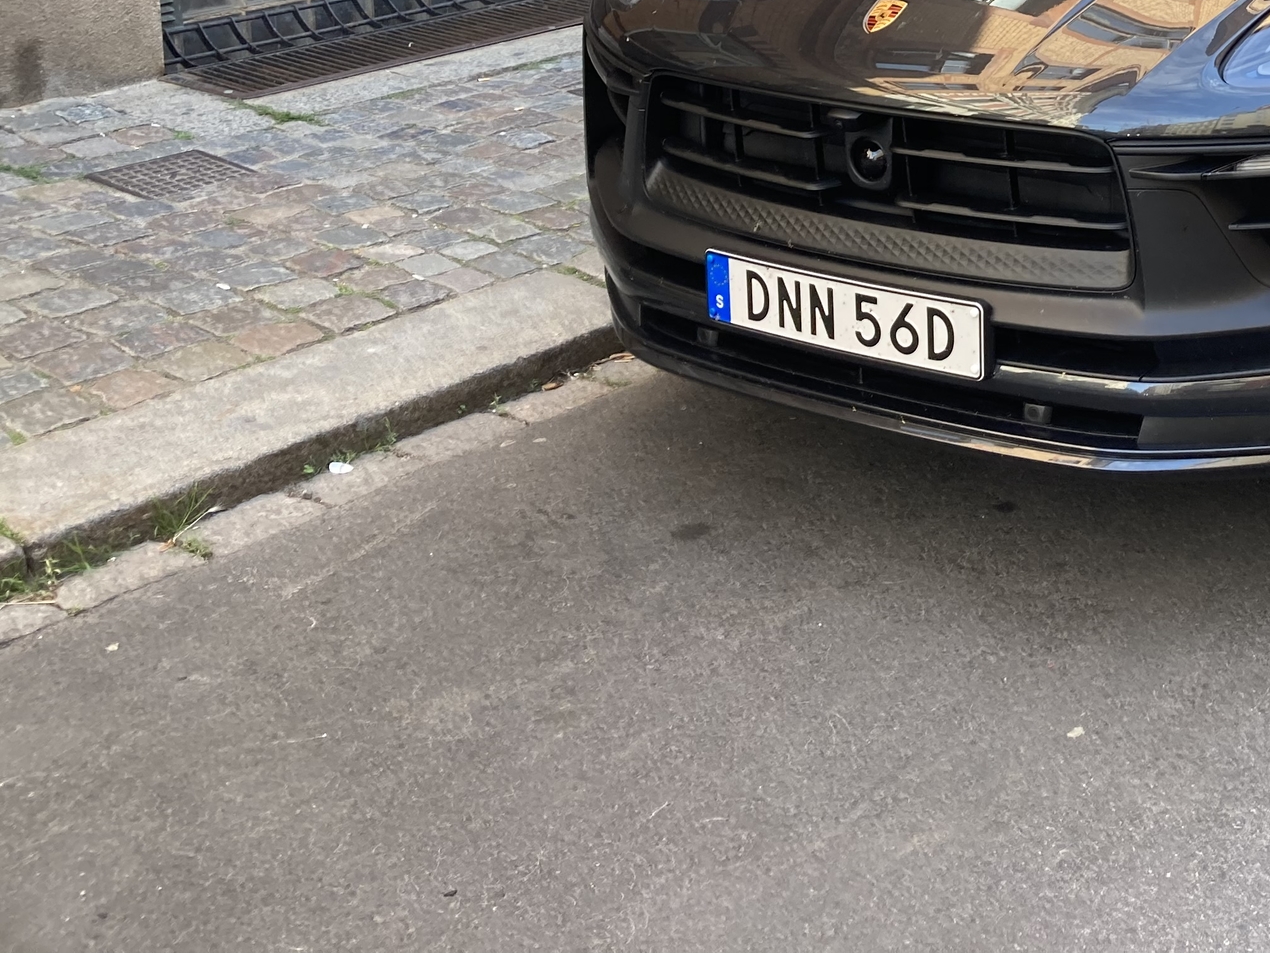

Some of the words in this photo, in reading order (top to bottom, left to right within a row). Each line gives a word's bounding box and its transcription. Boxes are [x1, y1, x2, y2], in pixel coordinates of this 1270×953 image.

[715, 294, 724, 308] S
[746, 269, 835, 340] DNN
[855, 292, 955, 361] 56D
